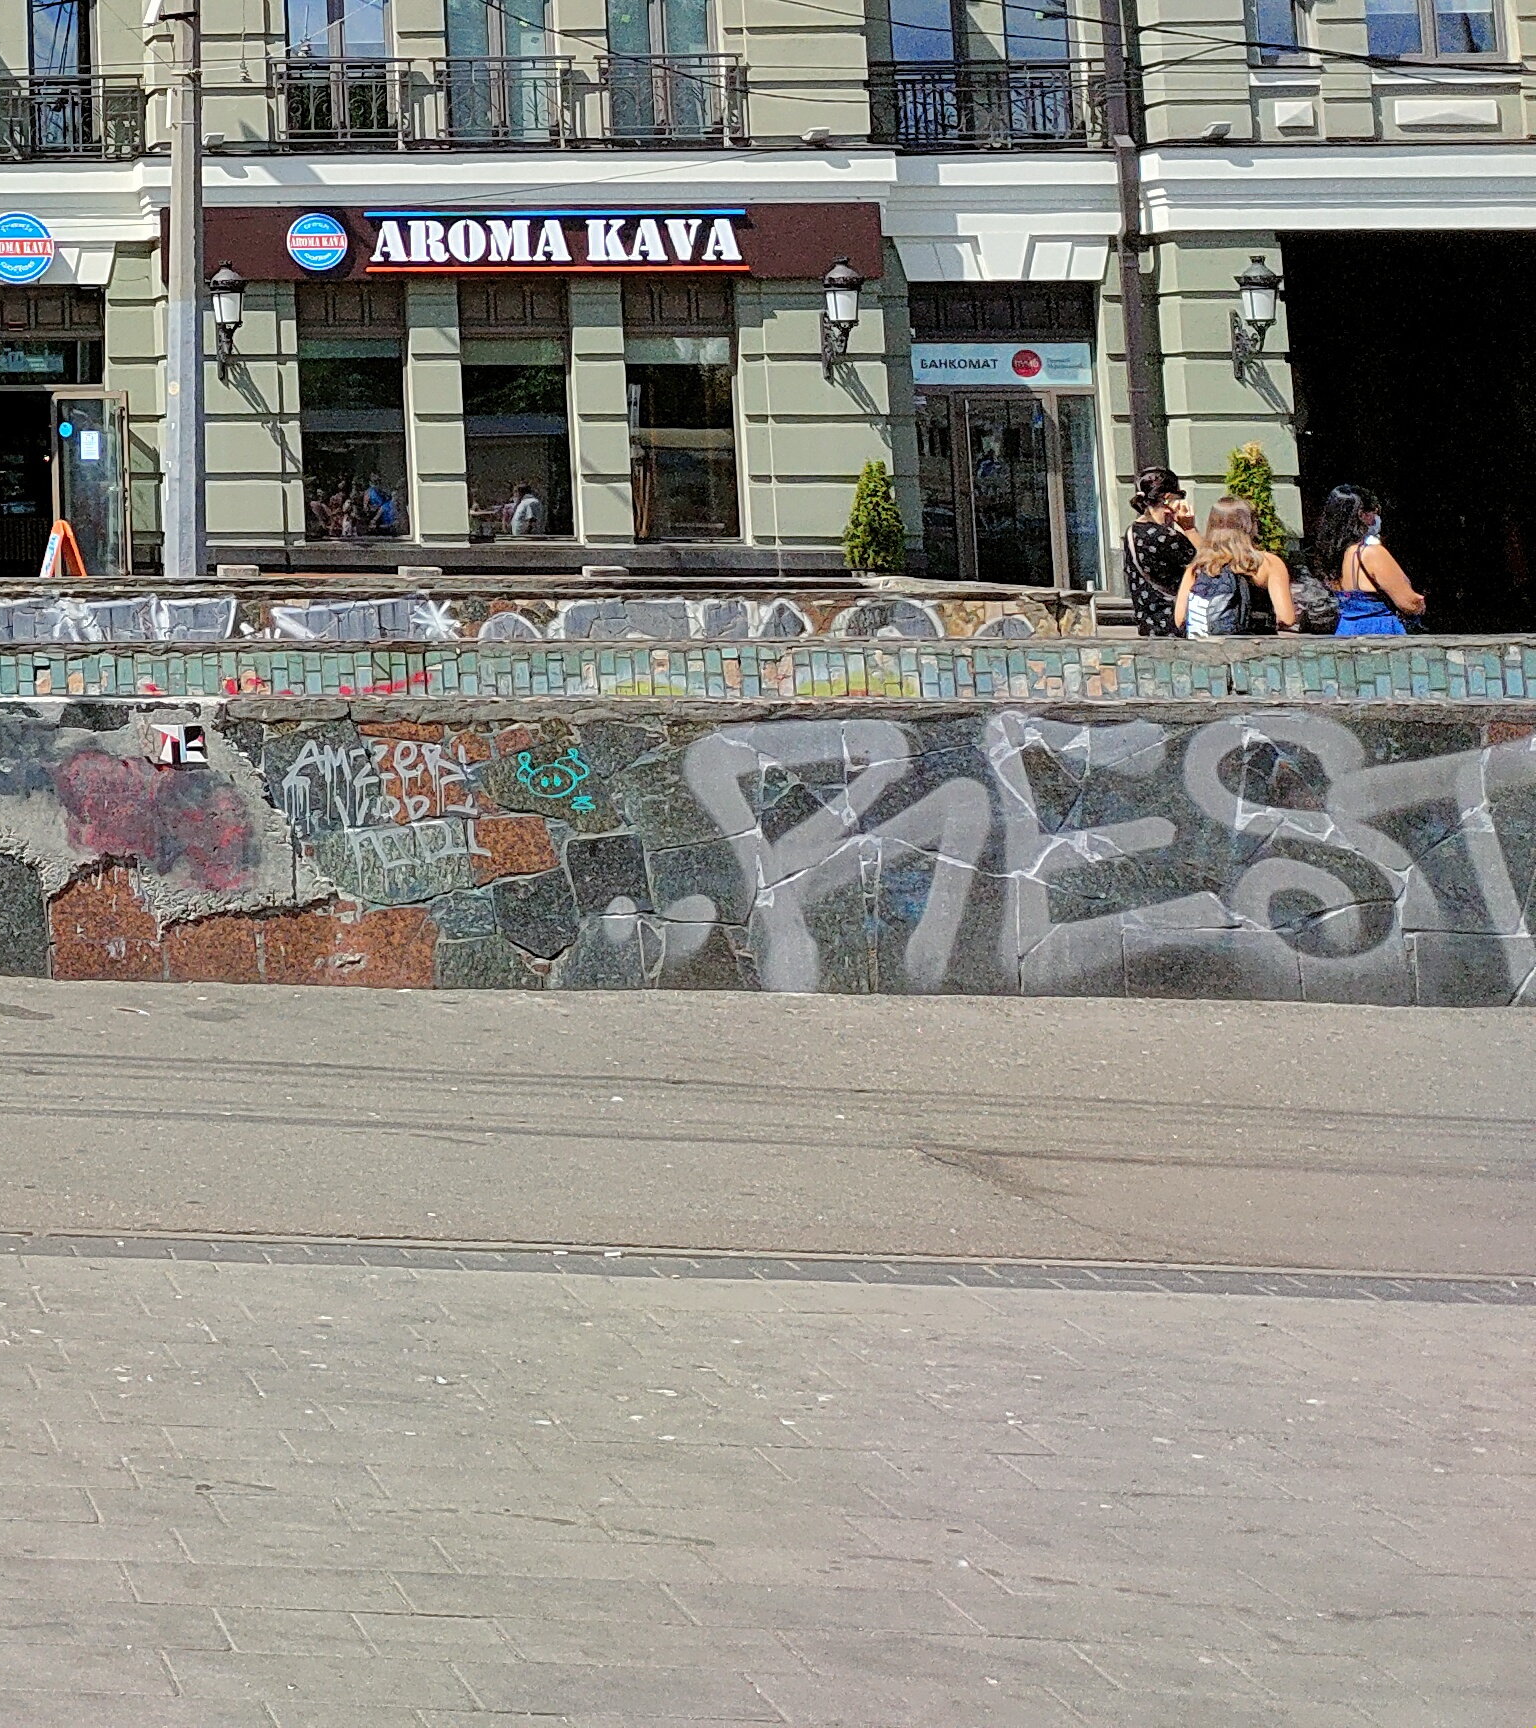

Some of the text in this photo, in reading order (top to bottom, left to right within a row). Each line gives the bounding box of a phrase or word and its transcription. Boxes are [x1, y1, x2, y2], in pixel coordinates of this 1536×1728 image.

[23, 241, 51, 254] KAVA
[369, 219, 743, 263] AROMA KAVA
[920, 358, 999, 370] БАНКОМАТ
